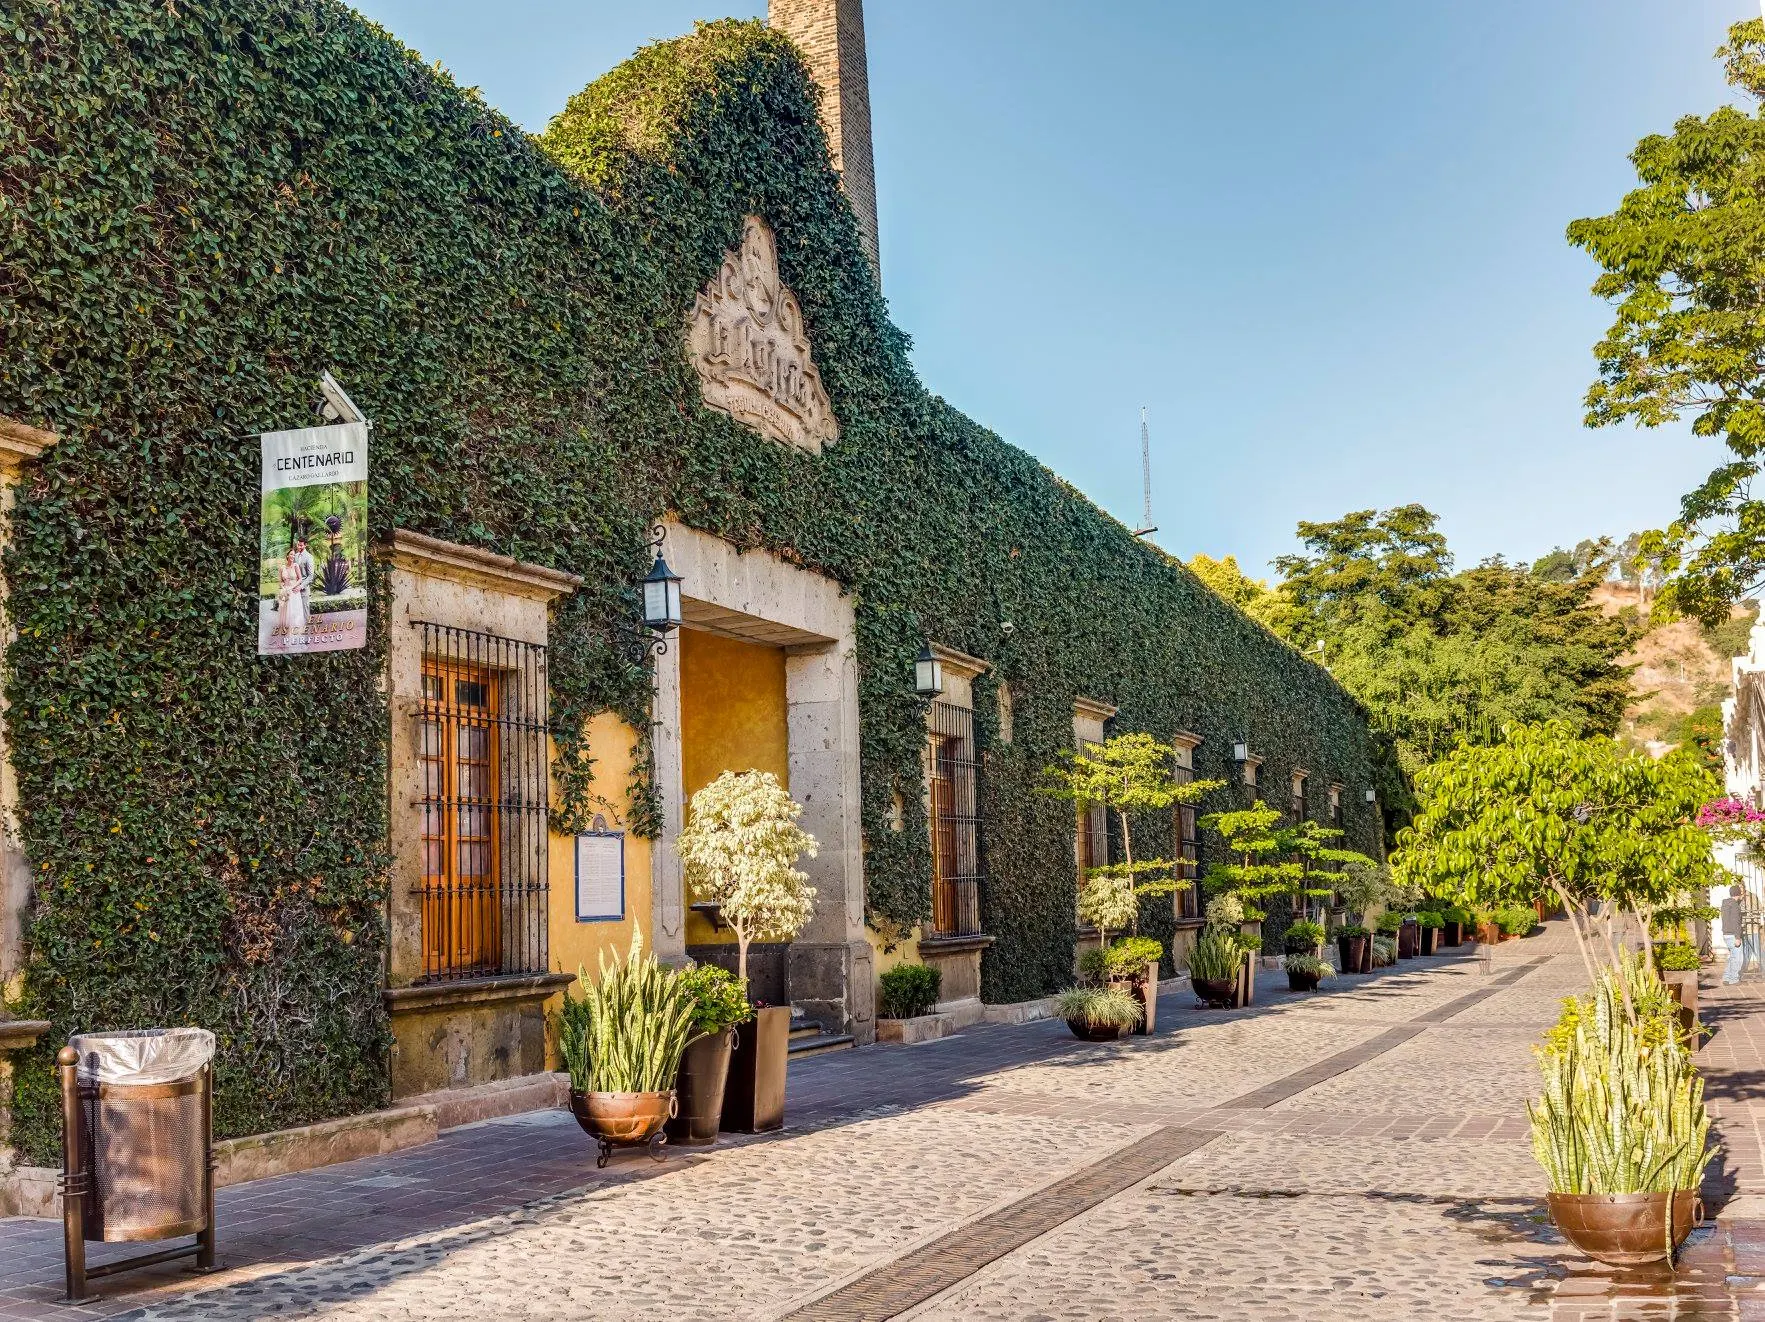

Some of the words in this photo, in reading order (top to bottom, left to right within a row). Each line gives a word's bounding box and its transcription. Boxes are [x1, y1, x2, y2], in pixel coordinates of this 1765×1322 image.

[277, 451, 354, 471] CENTENARIO
[308, 614, 323, 625] EL
[271, 619, 354, 637] ESCENARIO
[283, 633, 343, 646] PERFECTO
